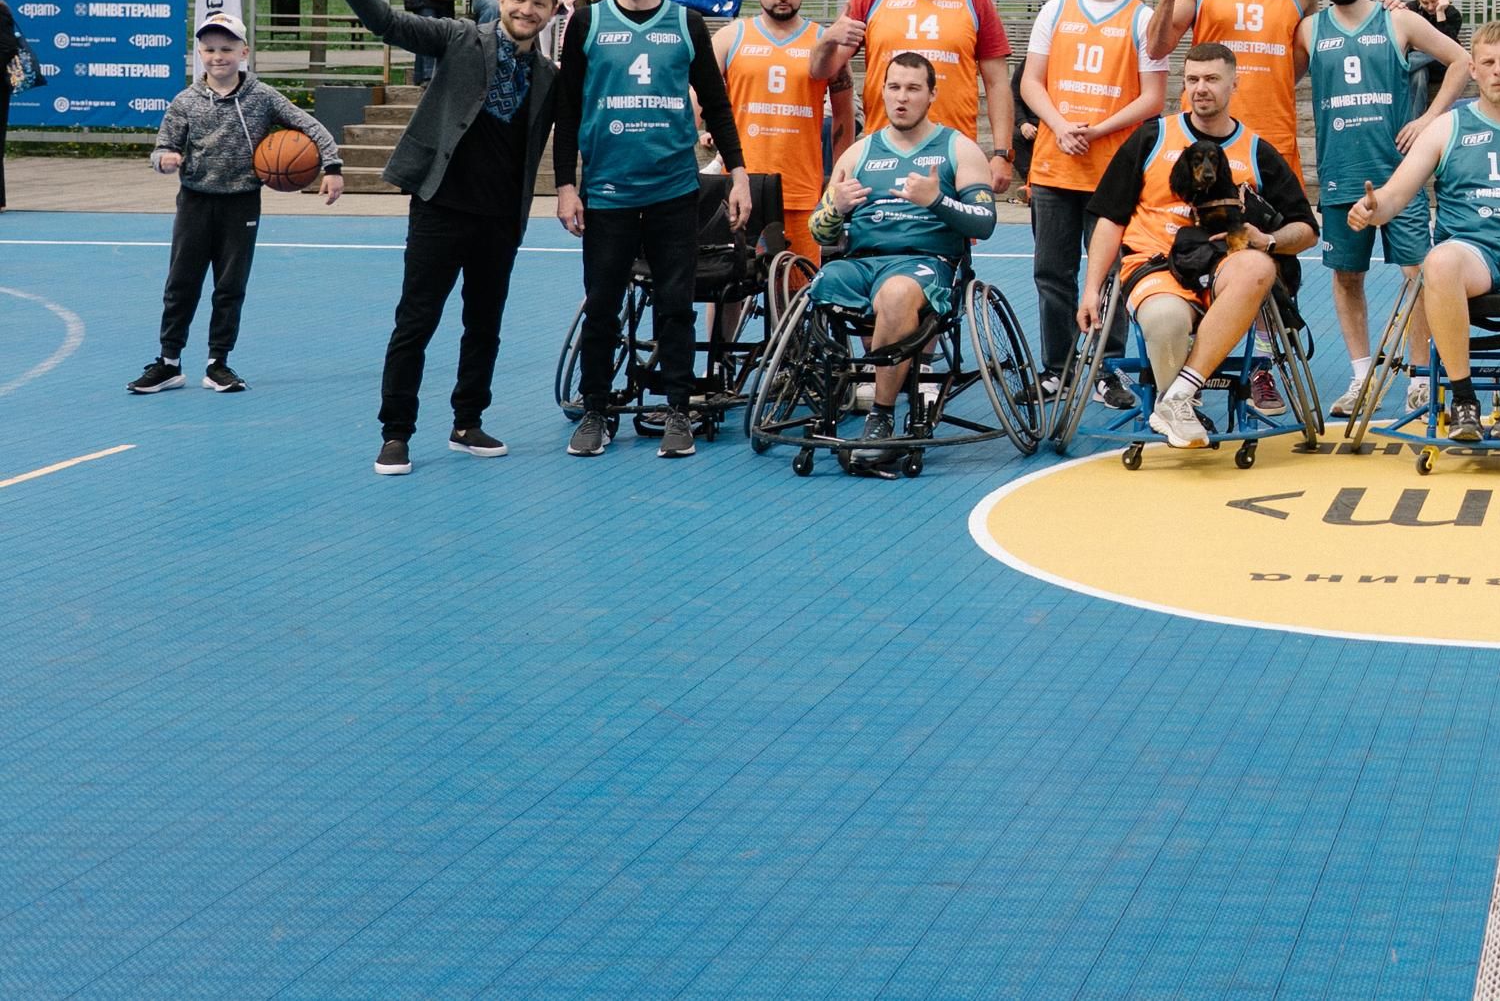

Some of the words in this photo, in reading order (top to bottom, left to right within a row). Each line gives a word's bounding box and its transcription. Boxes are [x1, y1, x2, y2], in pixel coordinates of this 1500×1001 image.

[88, 3, 171, 18] МІНВЕТЕРАНІВ
[1234, 2, 1264, 32] 13
[905, 14, 939, 40] 14
[600, 33, 630, 43] ГАРТ
[1319, 38, 1343, 49] ГАРТ
[1073, 43, 1105, 74] 10
[88, 63, 170, 78] МІНВЕТЕРАНІВ
[628, 53, 652, 85] 4
[1343, 55, 1362, 85] 9
[768, 65, 787, 94] 6
[606, 95, 684, 109] МІНВЕТЕРАНІВ
[1330, 92, 1393, 109] МІНВЕТЕРАНІВ
[748, 102, 814, 118] МІНВЕТЕРАНІВ
[1464, 132, 1491, 144] ГАРТ
[868, 159, 895, 169] ГАРТ
